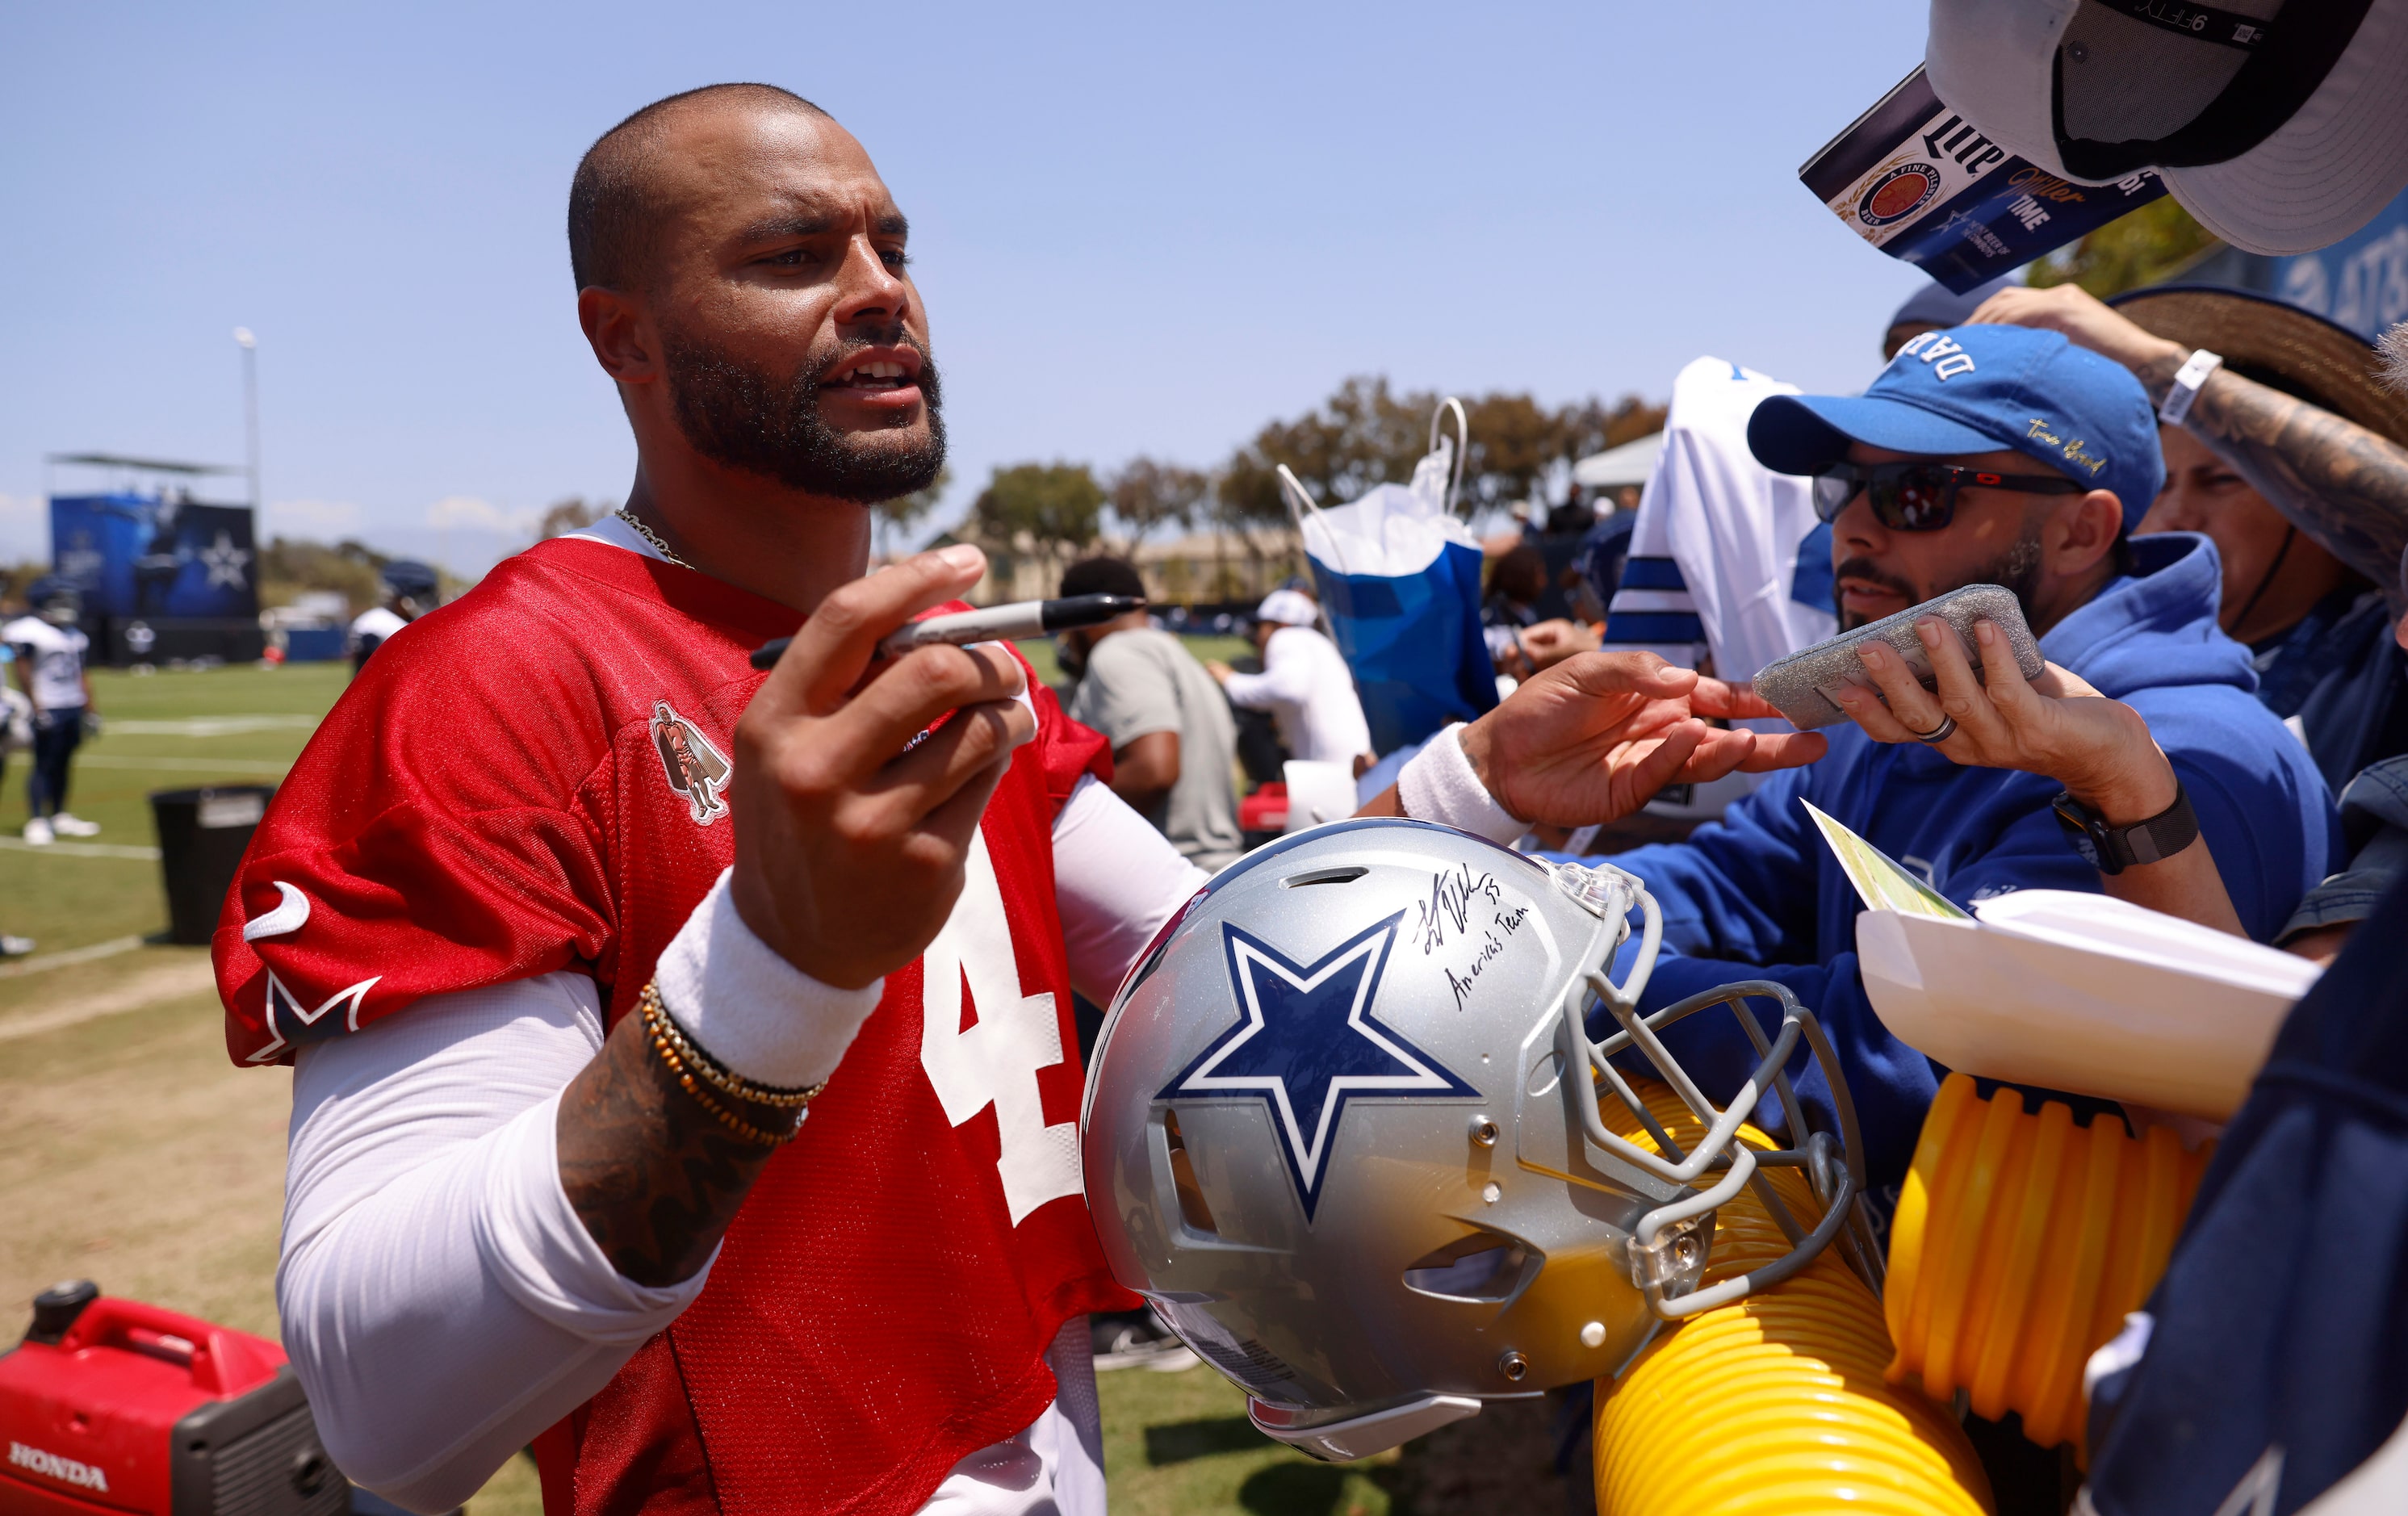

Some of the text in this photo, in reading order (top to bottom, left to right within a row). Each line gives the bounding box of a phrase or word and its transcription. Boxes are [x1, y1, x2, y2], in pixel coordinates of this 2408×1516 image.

[1900, 164, 1928, 174] FINE
[1917, 170, 1939, 206] PILSNER
[1861, 209, 1882, 225] BEER
[1494, 907, 1529, 936] Team
[919, 822, 1083, 1229] 4
[9, 1441, 109, 1493] HONDA
